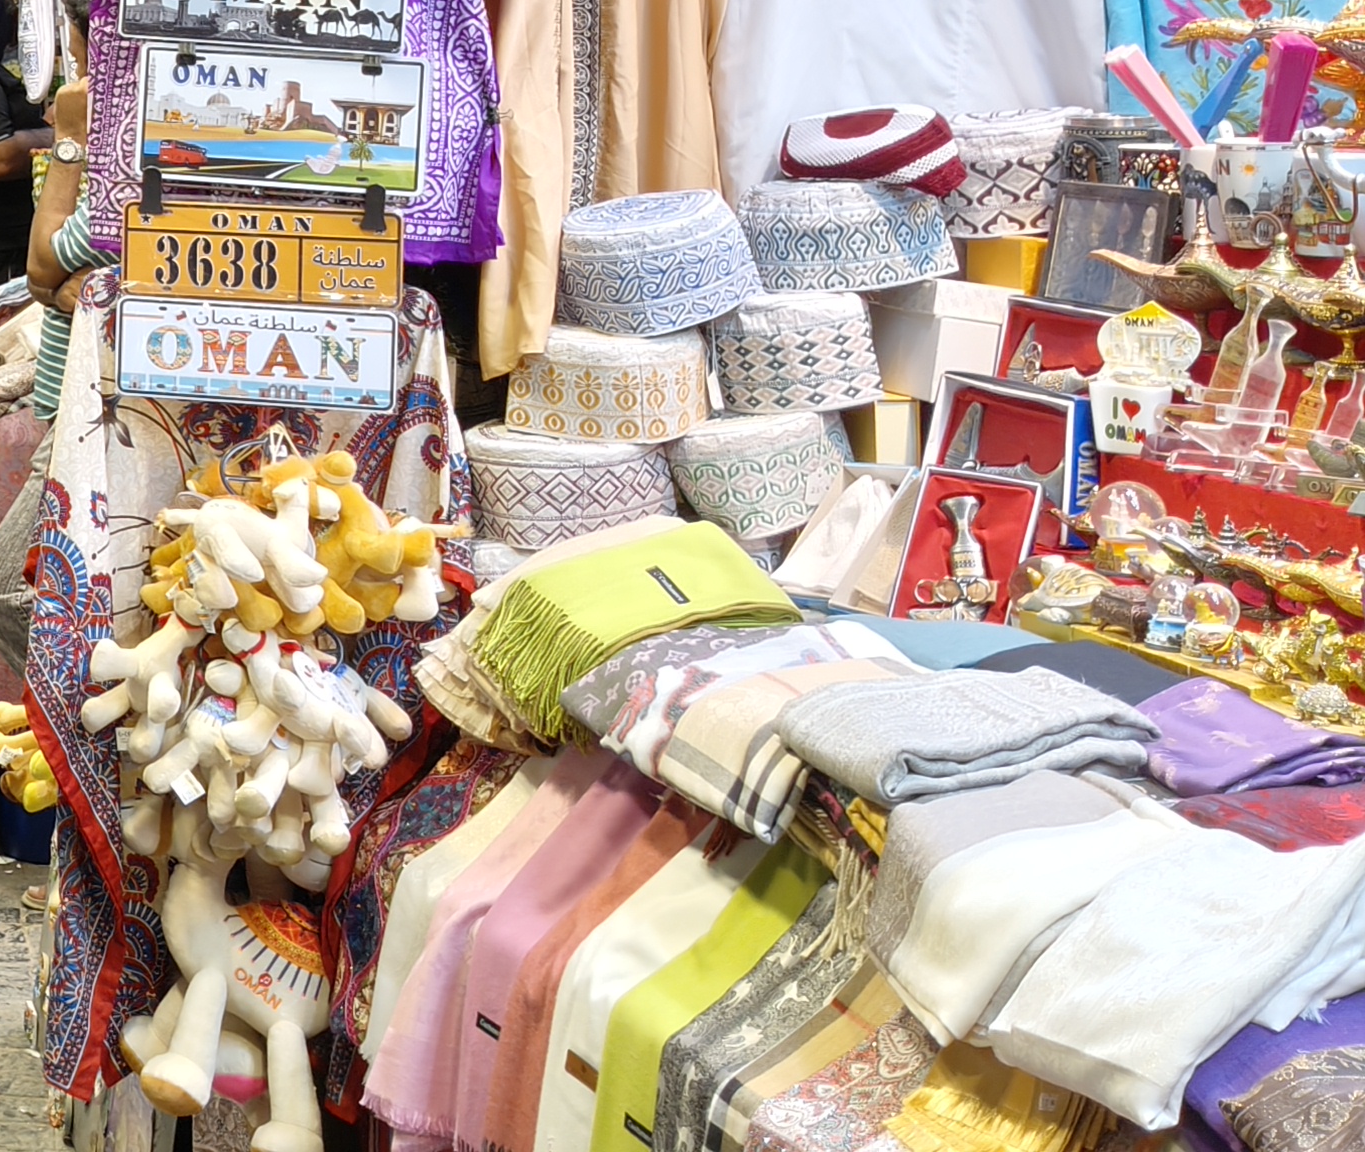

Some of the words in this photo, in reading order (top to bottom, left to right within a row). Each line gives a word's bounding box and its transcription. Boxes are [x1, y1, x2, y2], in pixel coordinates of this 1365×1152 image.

[172, 62, 268, 89] OMAN
[212, 212, 314, 233] OMAN
[155, 234, 278, 290] 3638
[312, 244, 386, 269] سلطنة
[319, 268, 376, 290] عمان
[192, 308, 246, 327] عمان
[248, 313, 318, 334] سلطنة
[1124, 316, 1155, 328] OMAN
[146, 325, 367, 383] OMAN
[1112, 396, 1119, 420] I
[1076, 441, 1098, 510] OMAN
[233, 967, 283, 1011] OMAN
